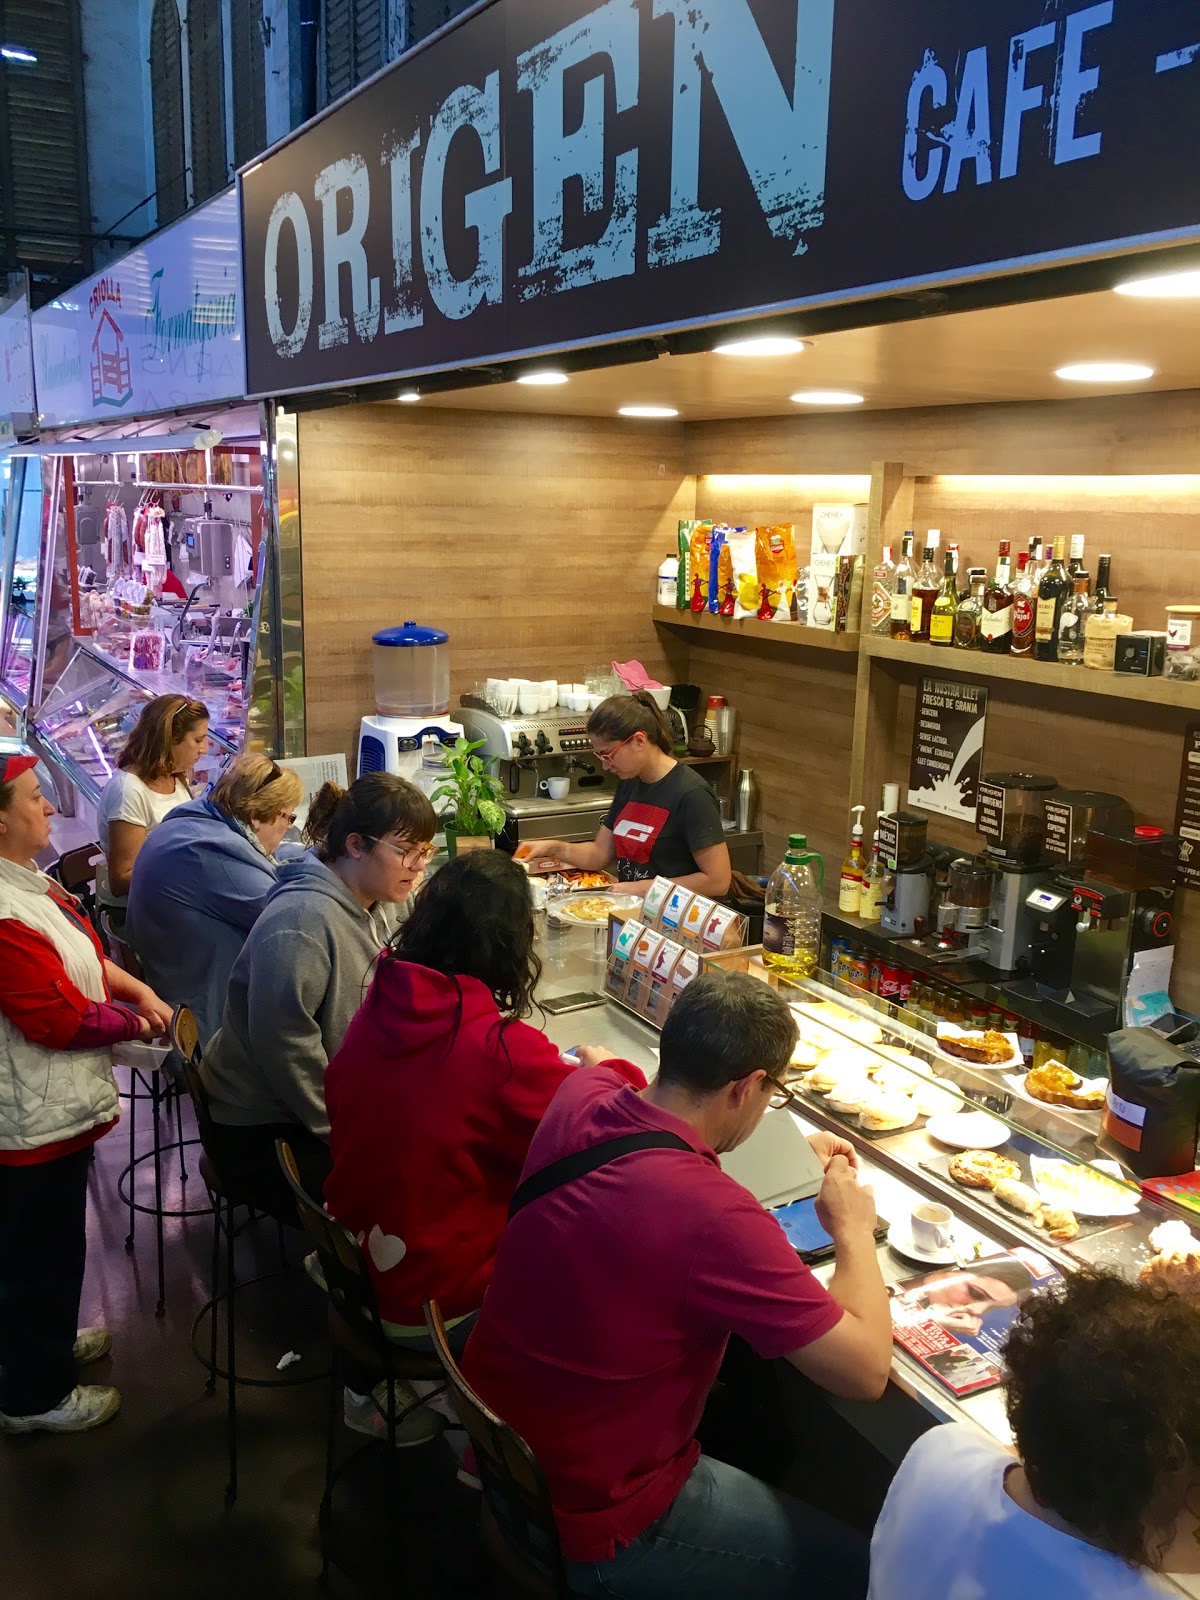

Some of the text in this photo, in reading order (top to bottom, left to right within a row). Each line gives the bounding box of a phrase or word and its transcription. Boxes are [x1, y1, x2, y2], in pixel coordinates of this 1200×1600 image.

[902, 5, 1113, 201] CAFE
[263, 0, 834, 361] ORIGEN
[89, 277, 122, 319] CRIOLLA
[820, 511, 843, 519] CHEMEX
[814, 559, 834, 567] CHEMEX
[923, 680, 980, 700] LA NOSTRA LLET
[922, 694, 978, 714] FRESCA DE GRANJA
[979, 786, 1002, 797] ORIGEN
[1045, 805, 1069, 816] ORIGEN
